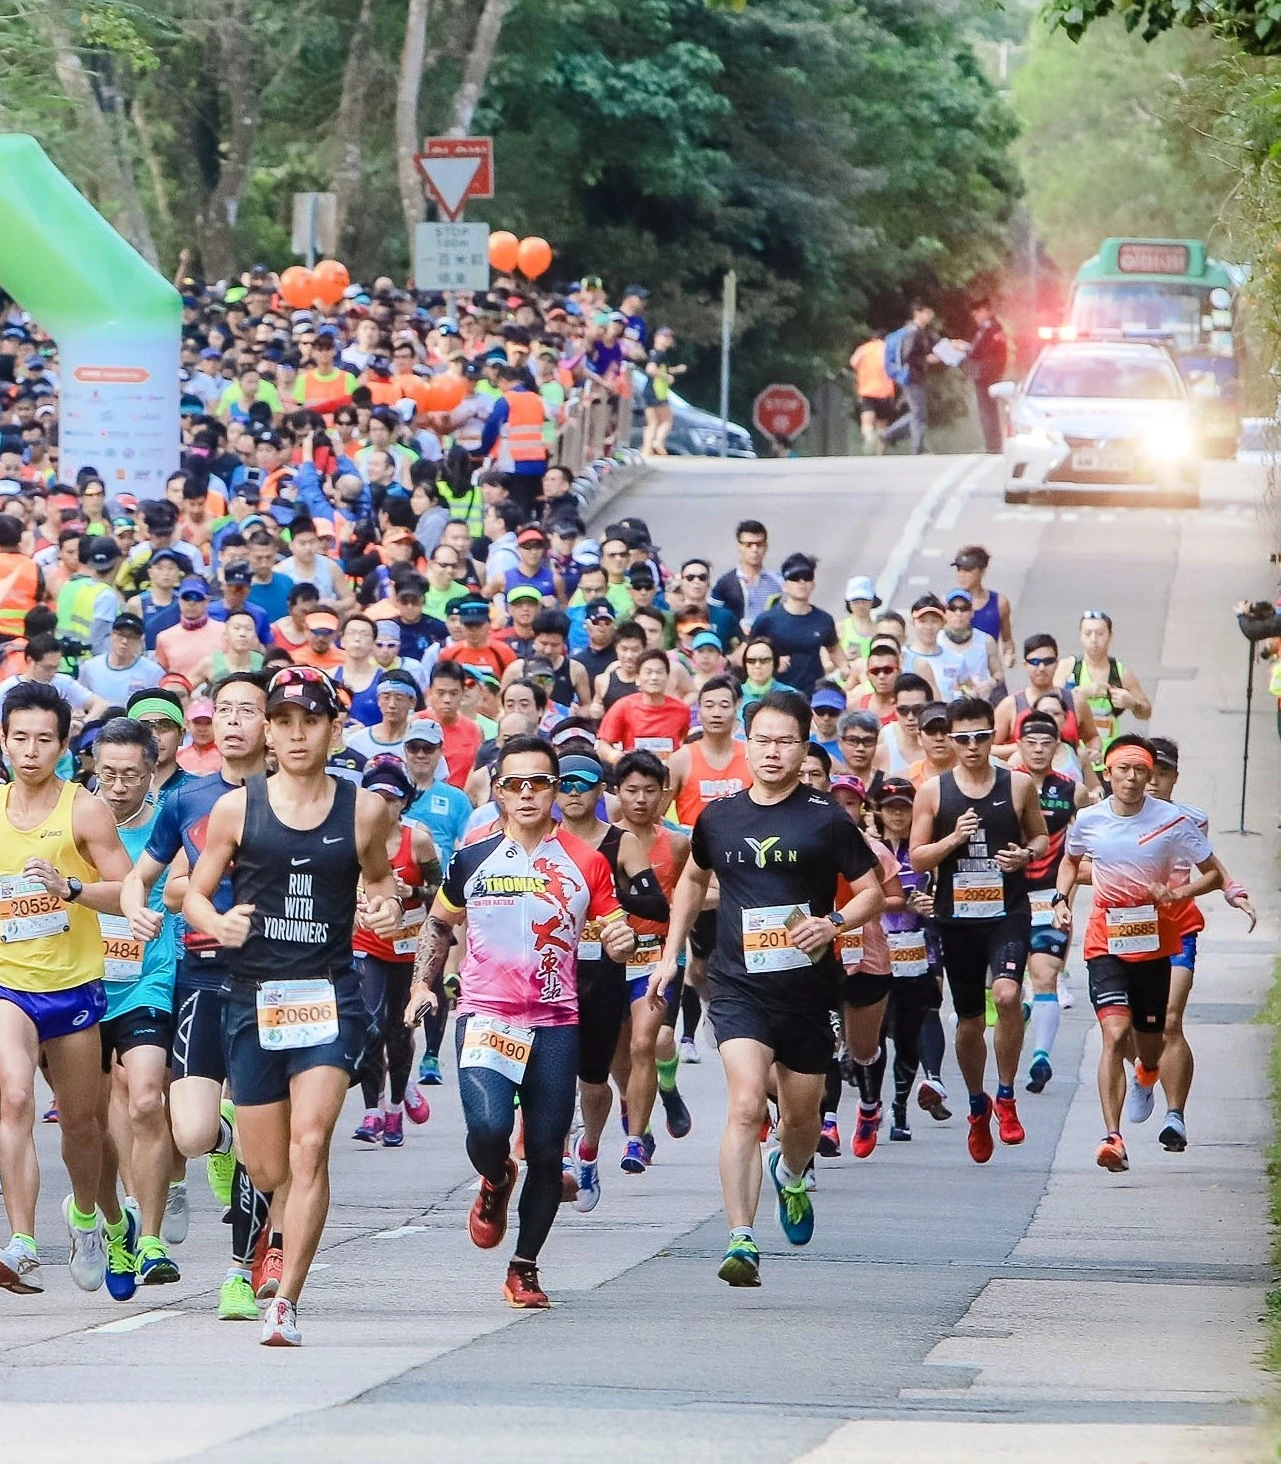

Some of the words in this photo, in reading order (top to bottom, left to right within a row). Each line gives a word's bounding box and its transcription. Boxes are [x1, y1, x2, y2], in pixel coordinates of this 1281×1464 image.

[288, 873, 313, 896] RUN
[484, 876, 547, 893] THOMAS
[964, 889, 1001, 901] 20922
[11, 895, 61, 917] 20552
[284, 896, 314, 920] WITH
[263, 916, 329, 943] YORUNNERS
[759, 931, 796, 948] 201
[1119, 922, 1156, 937] 20585
[275, 1004, 332, 1025] 20606
[479, 1032, 526, 1061] 20190
[239, 1171, 250, 1214] 2XU
